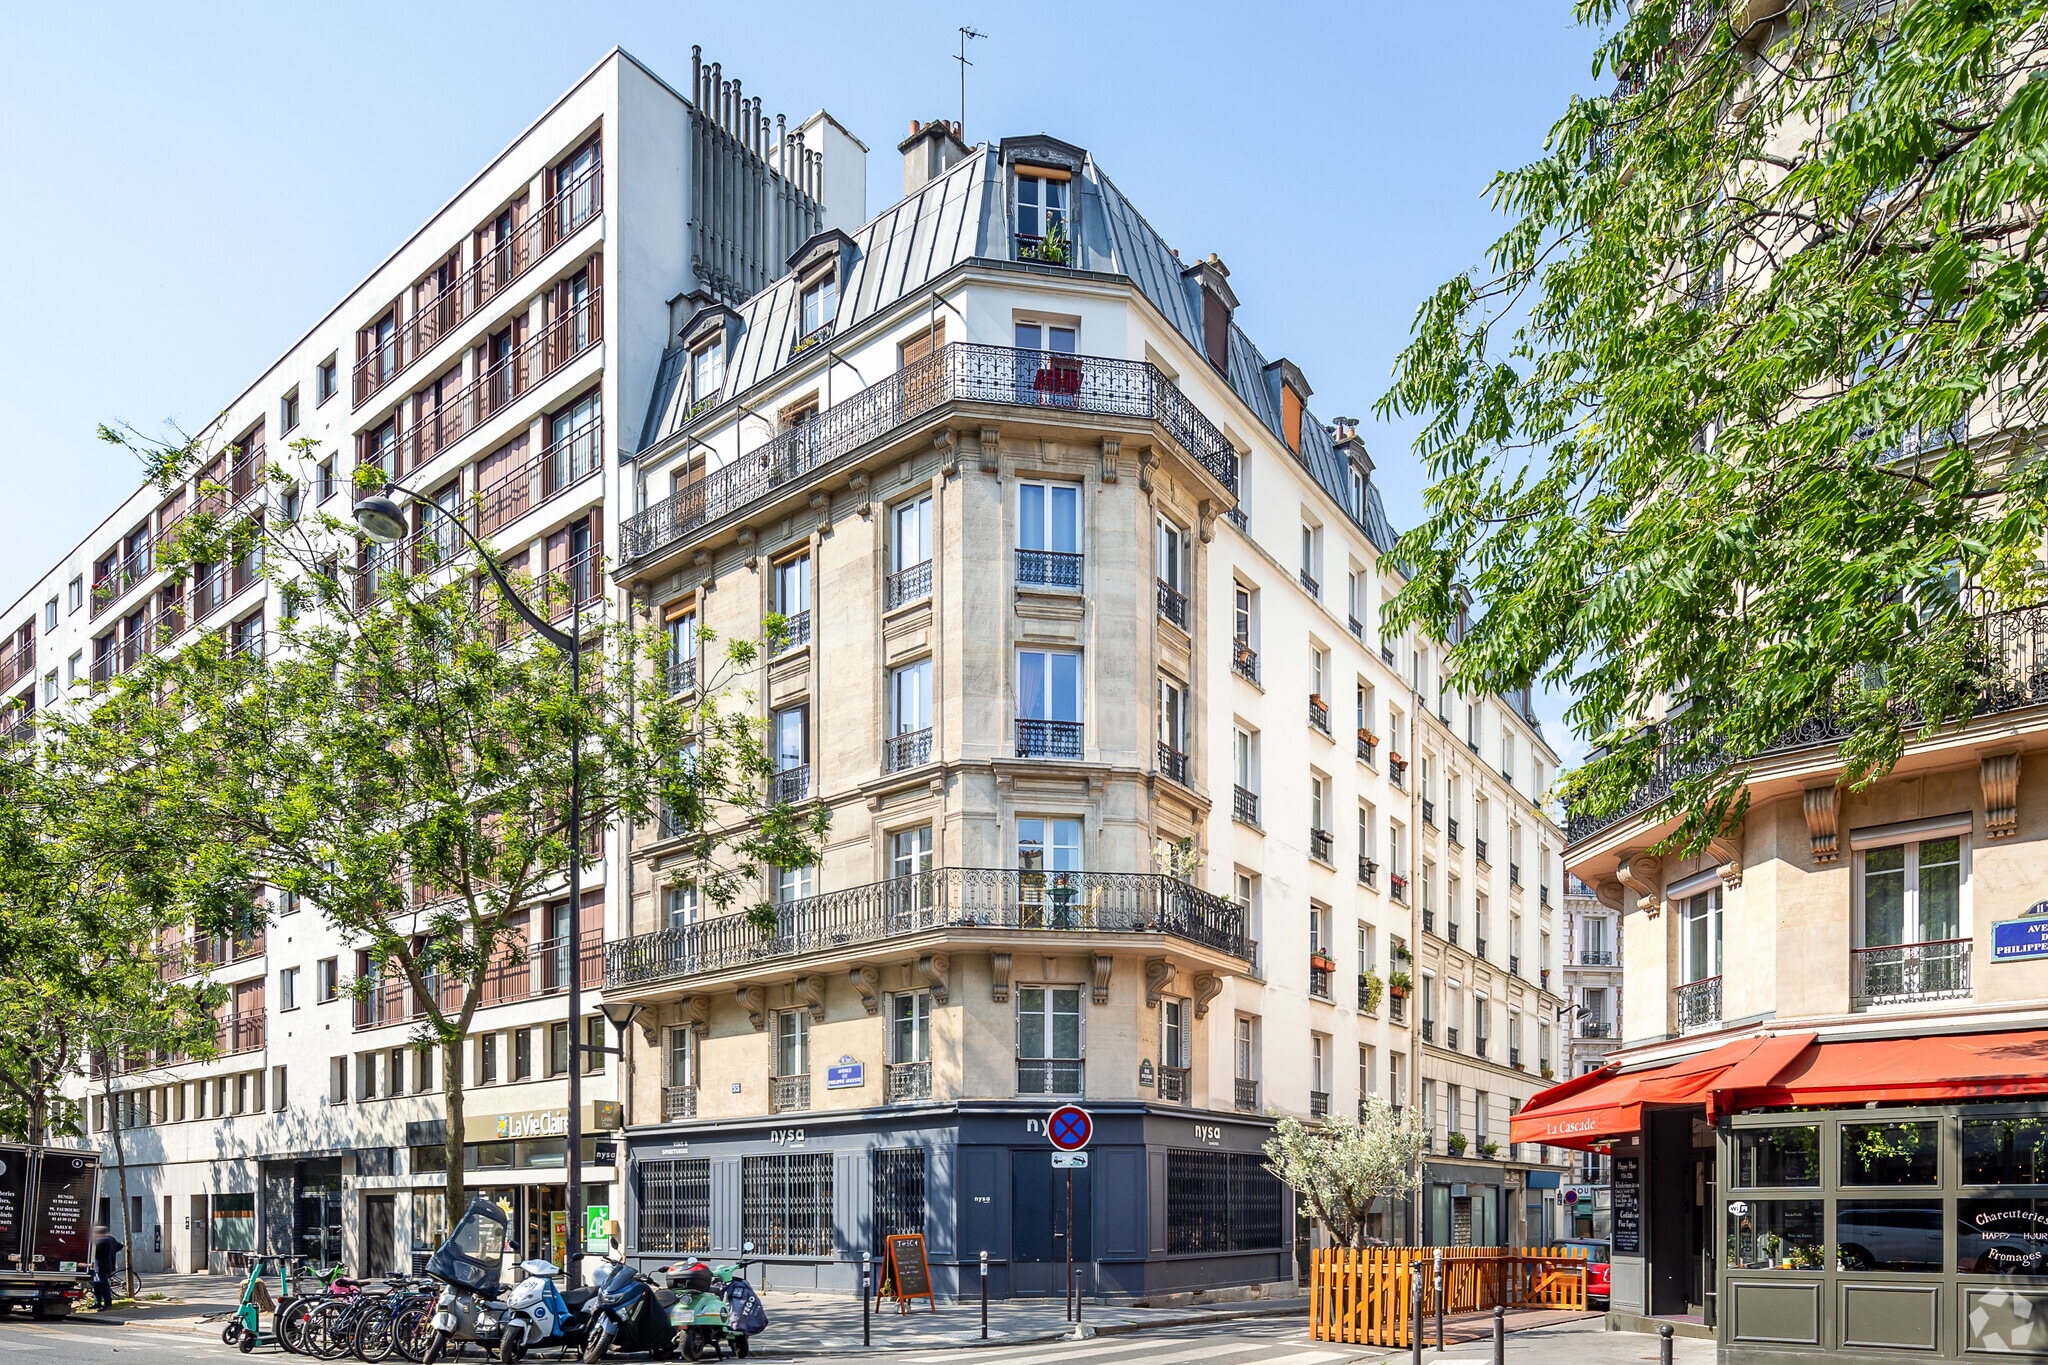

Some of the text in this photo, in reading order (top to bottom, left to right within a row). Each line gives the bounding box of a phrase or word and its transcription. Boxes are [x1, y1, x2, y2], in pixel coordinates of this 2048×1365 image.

[1996, 942, 2048, 954] PHILIPPE
[509, 1116, 522, 1137] La
[522, 1113, 540, 1136] Vie
[1195, 1125, 1221, 1142] nysa
[1547, 1118, 1596, 1135] La Cascade
[770, 1129, 805, 1146] nysa
[596, 1152, 616, 1160] nysa
[1975, 1209, 2048, 1225] Charcuteries
[1982, 1232, 2048, 1240] HAPPY HOUR
[1988, 1247, 2042, 1267] Fromages
